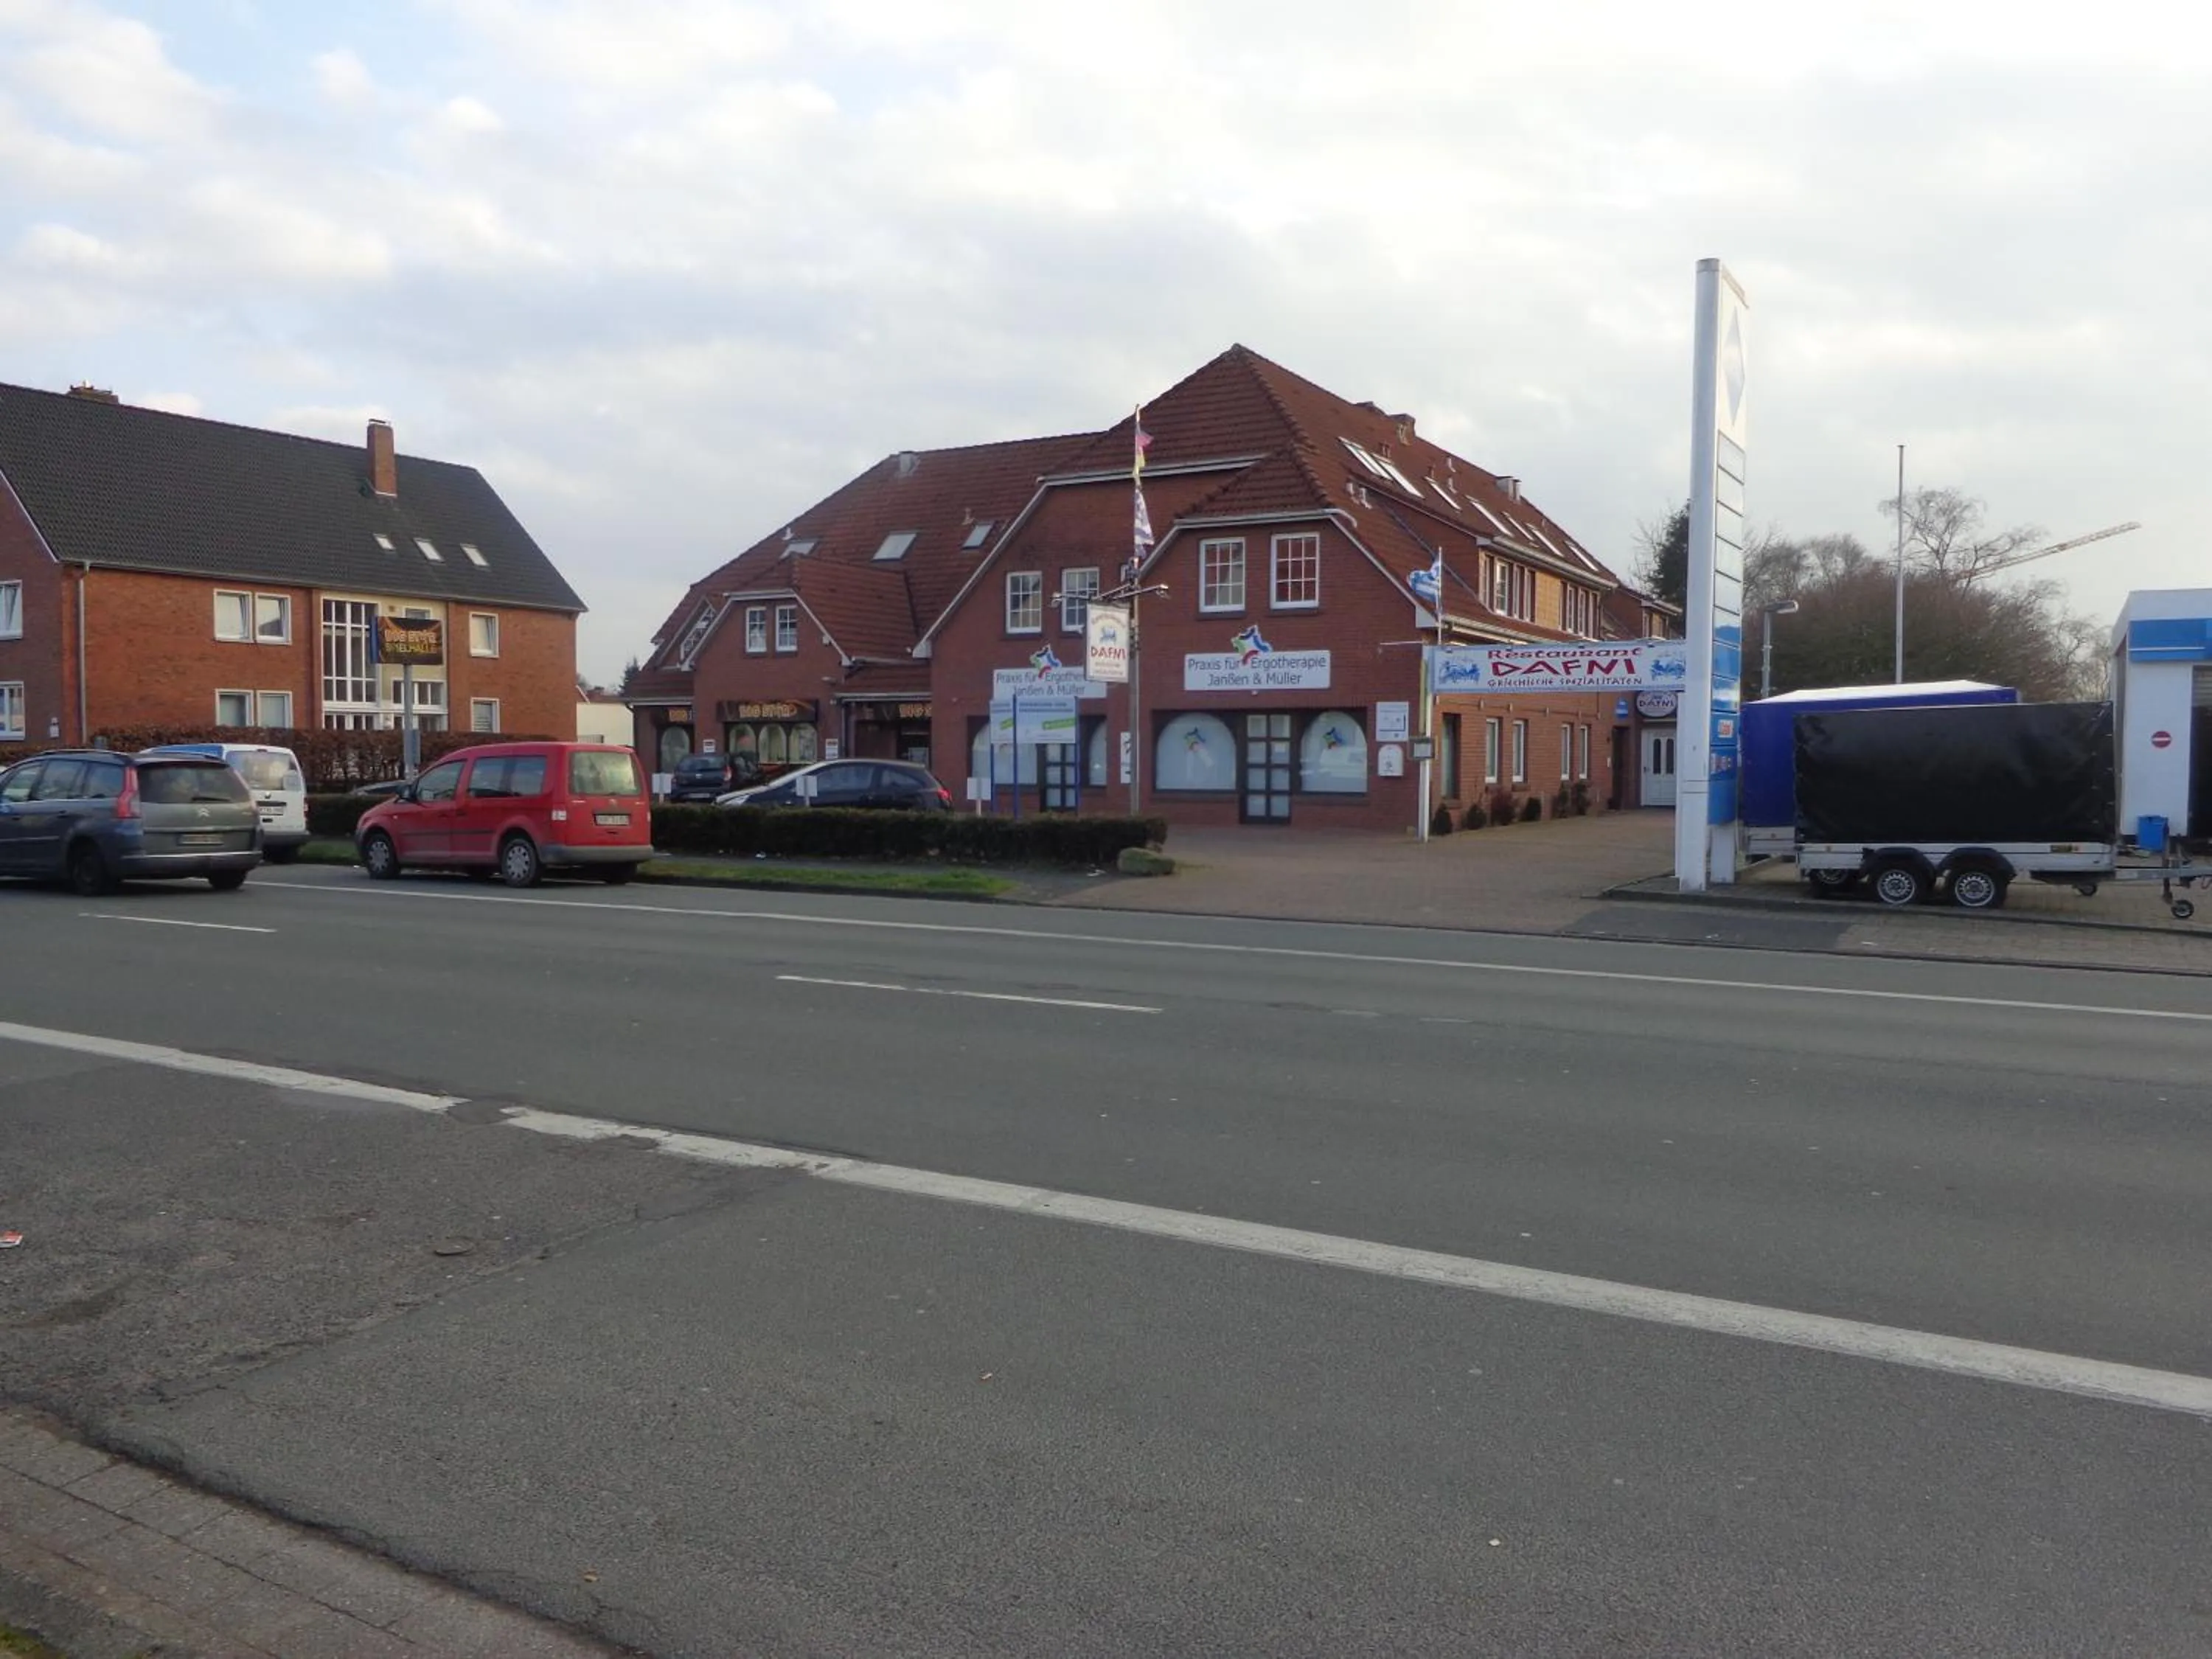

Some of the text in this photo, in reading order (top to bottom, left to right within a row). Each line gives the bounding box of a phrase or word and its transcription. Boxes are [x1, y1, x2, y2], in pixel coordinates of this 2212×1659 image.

[1091, 646, 1126, 660] DAFNI
[1487, 647, 1643, 659] Restaurant
[1189, 655, 1326, 672] Praxis für Ergotherapie
[1491, 658, 1636, 676] DAFNI
[996, 672, 1022, 683] Praxis
[1208, 671, 1303, 686] Janßen & Müller
